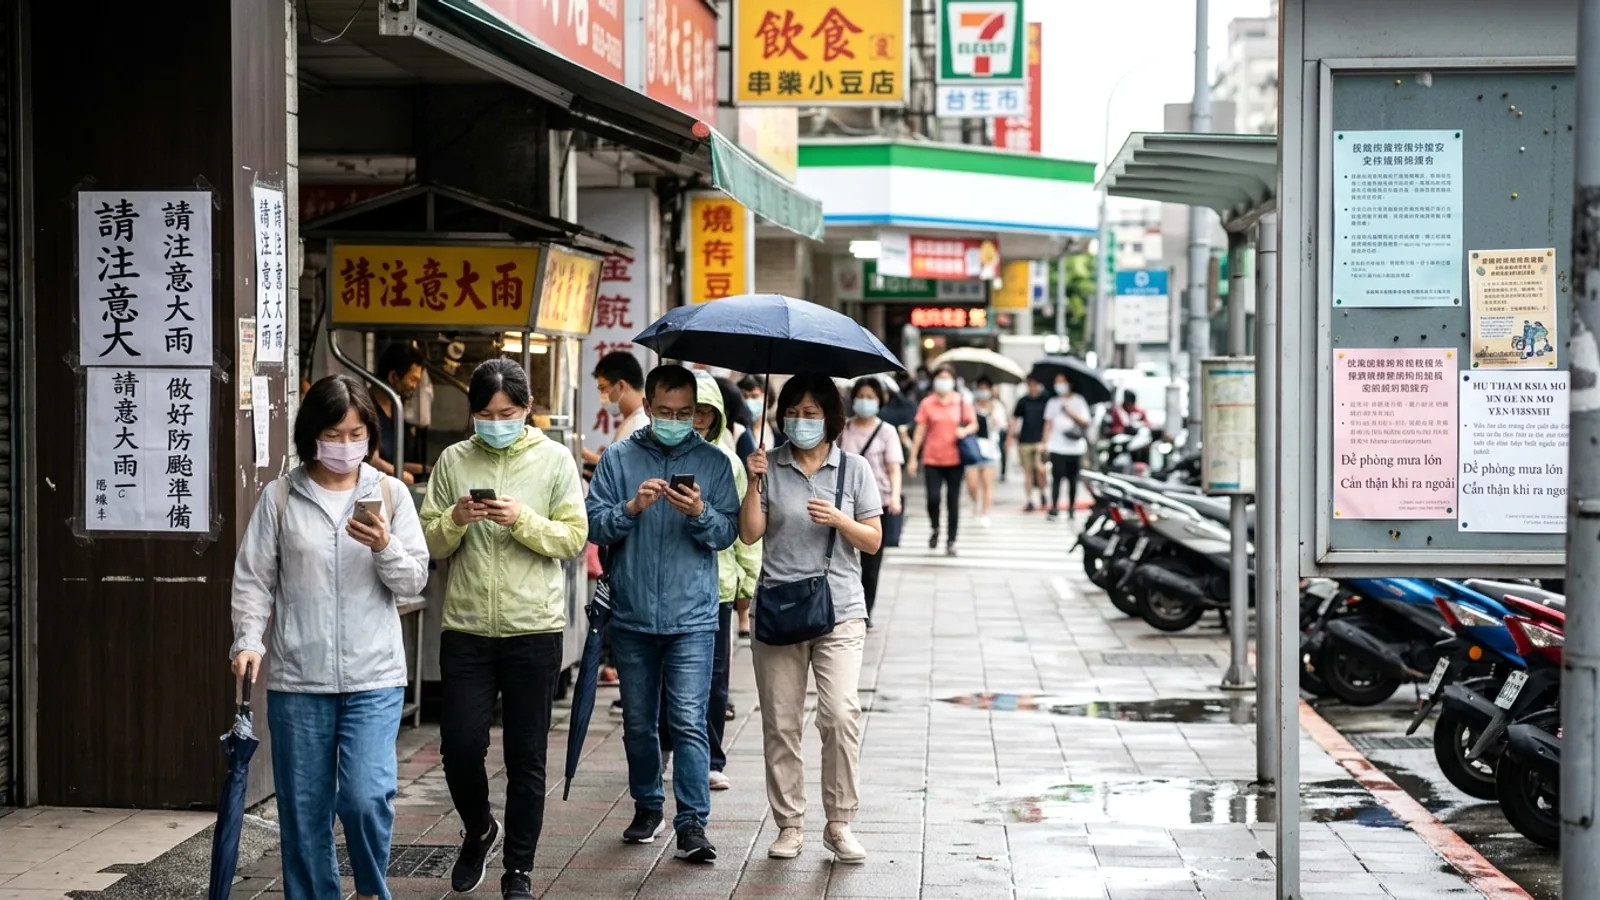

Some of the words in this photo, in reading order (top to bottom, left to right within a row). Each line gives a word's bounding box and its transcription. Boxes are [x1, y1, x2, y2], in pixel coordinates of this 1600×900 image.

[755, 7, 863, 62] 飲食
[94, 199, 141, 357] 請注意大
[161, 200, 195, 354] 請注意大雨
[340, 256, 523, 311] 請注意大雨
[166, 377, 194, 529] 做好防颱準備
[1360, 454, 1394, 468] phòng
[1481, 463, 1515, 477] phòng
[1391, 477, 1409, 489] khi
[1411, 480, 1423, 489] ra
[1512, 484, 1530, 495] khi
[1532, 486, 1544, 495] ra
